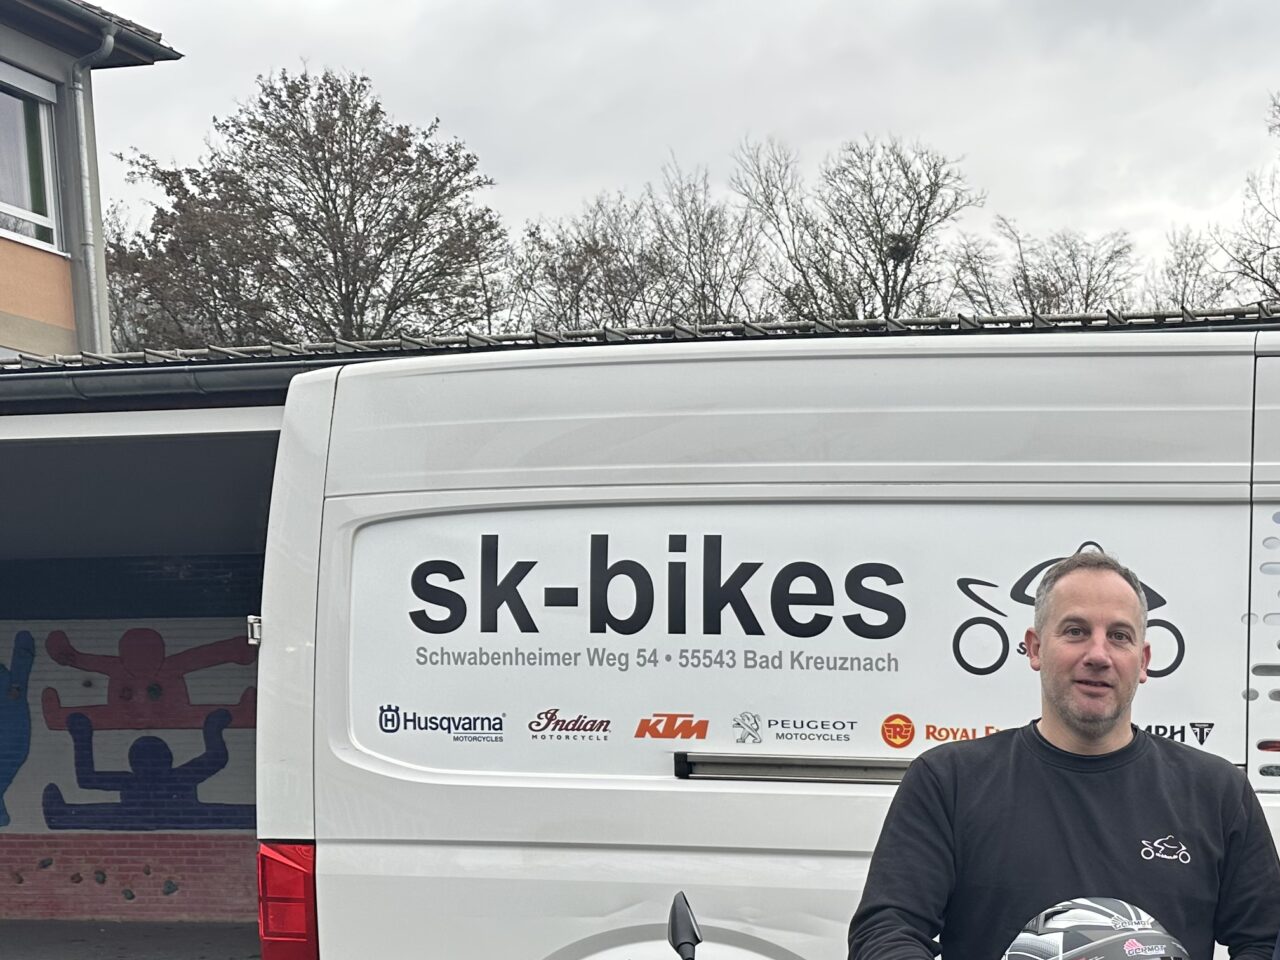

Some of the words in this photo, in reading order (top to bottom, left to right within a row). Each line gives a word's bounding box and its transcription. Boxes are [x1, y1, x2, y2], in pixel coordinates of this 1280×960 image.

[408, 533, 908, 641] sk-bikes
[415, 646, 582, 667] Schwabenheimer
[586, 647, 629, 672] Weg
[636, 648, 659, 668] 54
[678, 648, 737, 669] 55543
[743, 649, 783, 670] Bad
[790, 650, 899, 672] Kreuznach
[403, 711, 504, 734] Husqvarna
[527, 708, 612, 733] Indian
[633, 712, 710, 740] KTM
[767, 719, 859, 731] PEUGEOT
[452, 735, 504, 743] MOTORCYCLES
[531, 734, 609, 742] MOTORCYCLE
[775, 732, 851, 742] MOTOCYCLES
